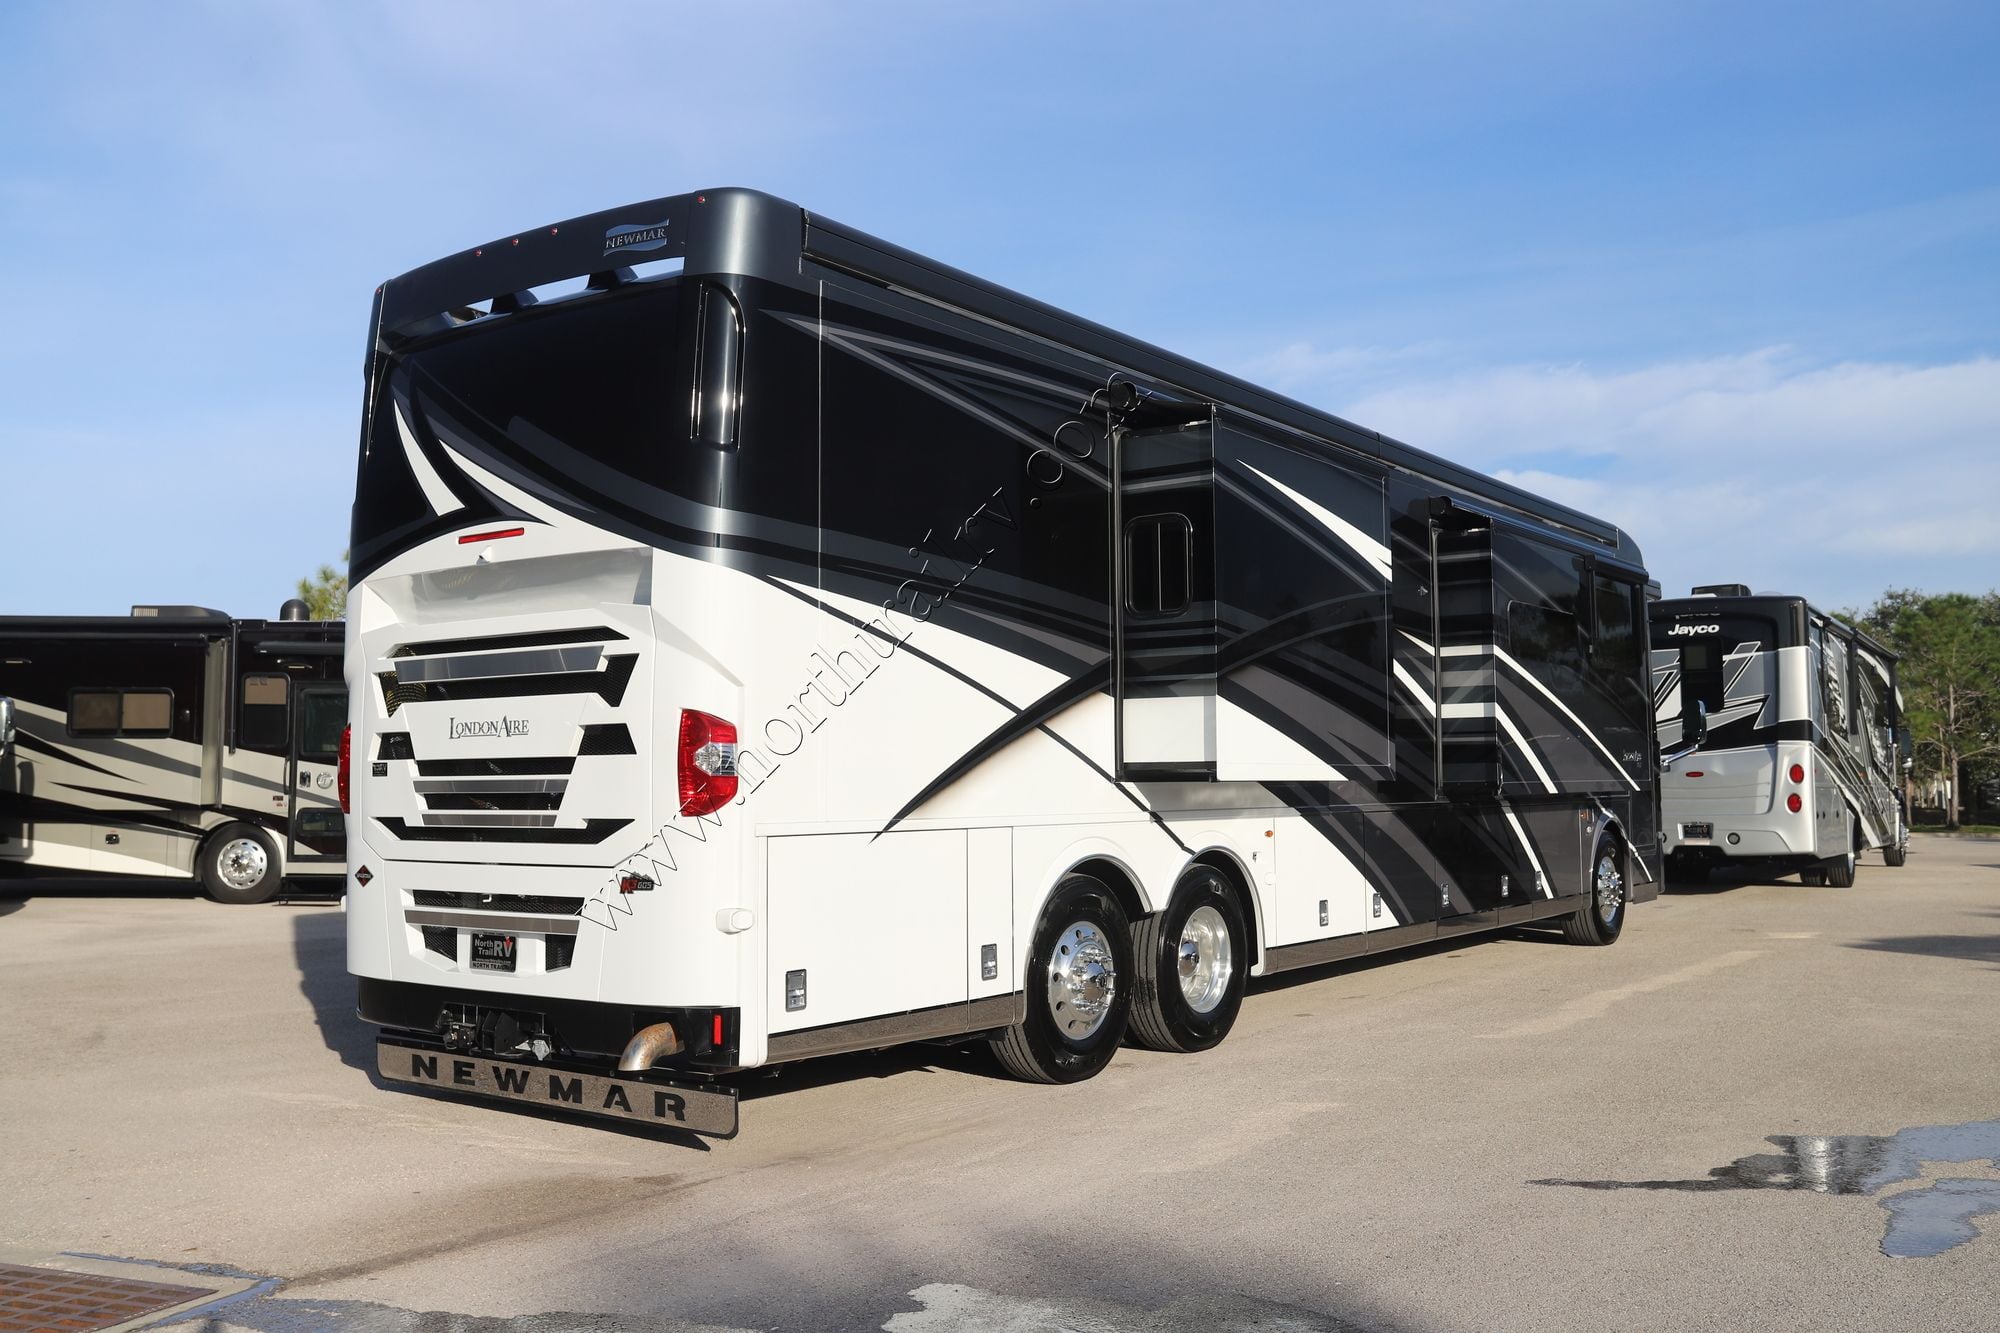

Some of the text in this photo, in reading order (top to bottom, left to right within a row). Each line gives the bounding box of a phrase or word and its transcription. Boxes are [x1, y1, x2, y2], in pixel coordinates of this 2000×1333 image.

[605, 228, 667, 249] NEWMAR
[1667, 623, 1720, 637] Jayco
[474, 938, 493, 948] North
[494, 940, 513, 957] RV
[478, 948, 493, 956] Trail
[411, 1054, 686, 1122] NEWMAR
